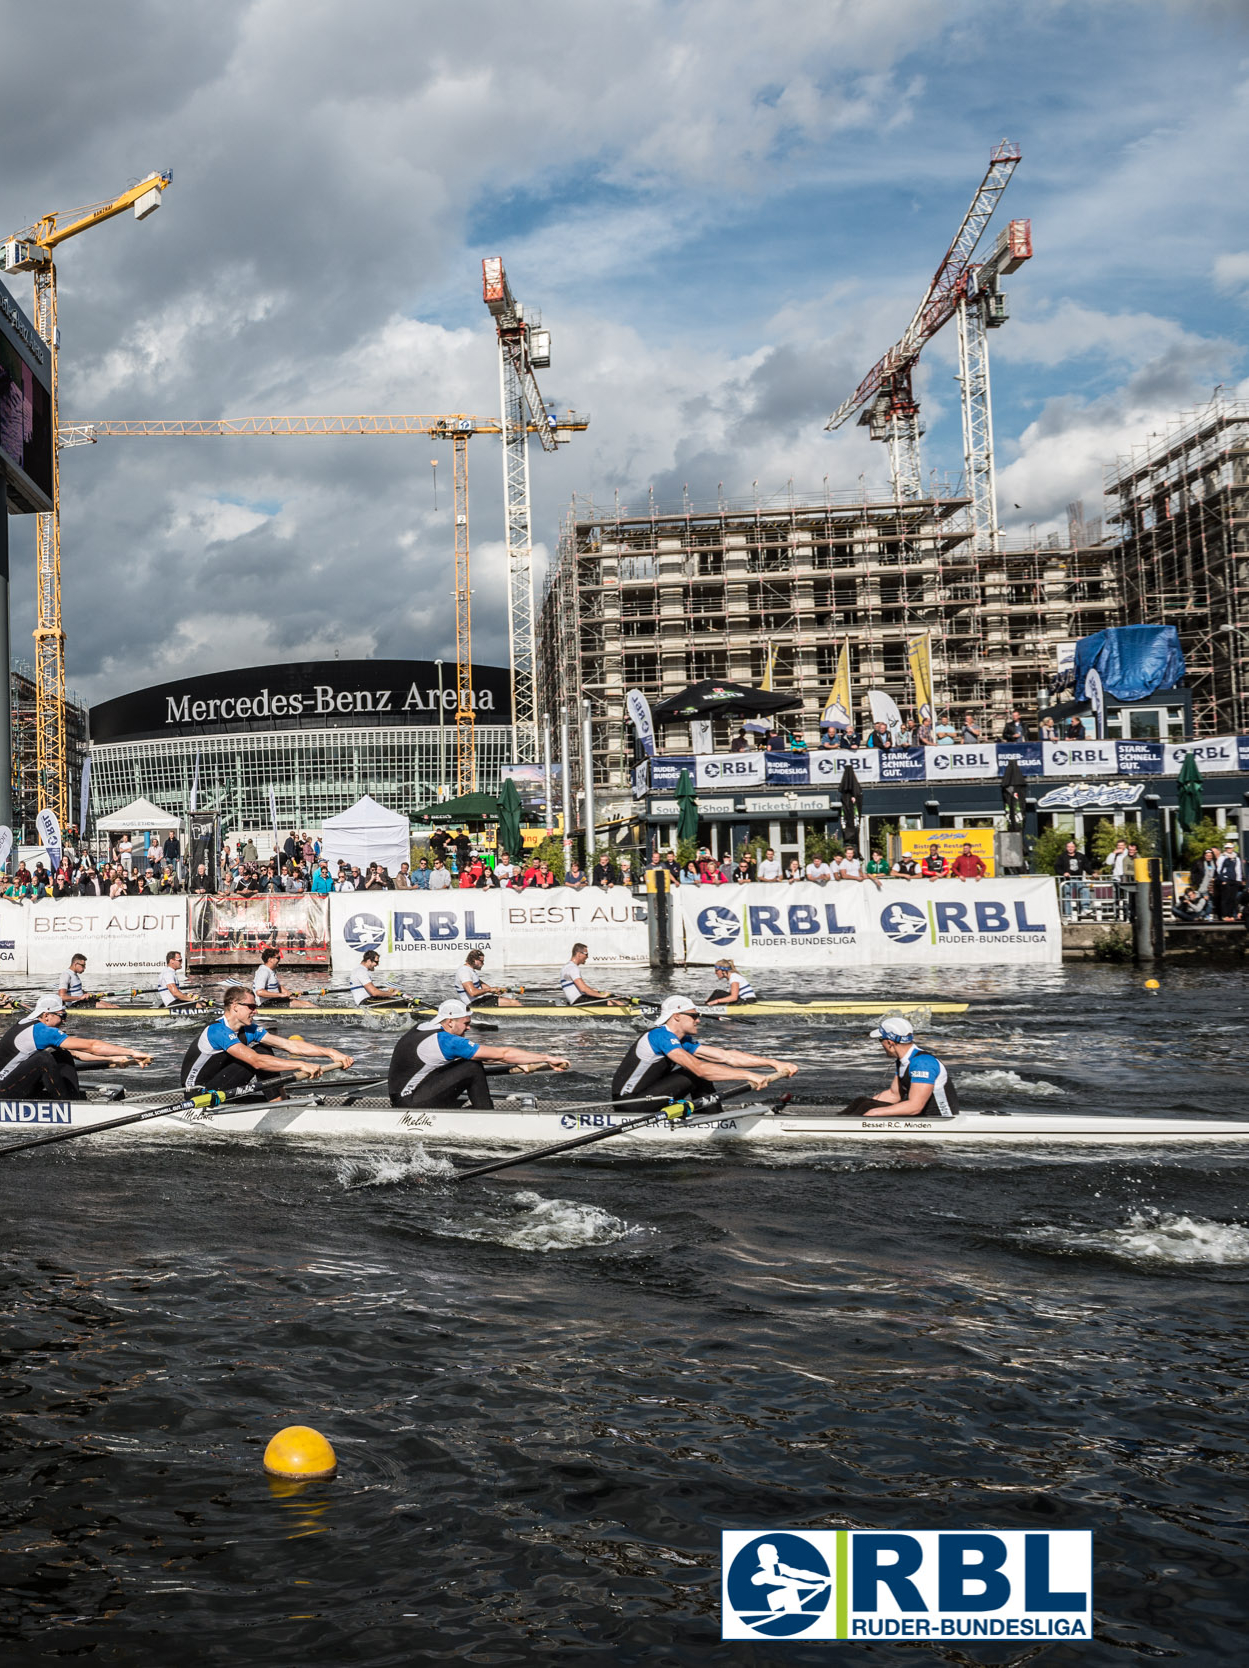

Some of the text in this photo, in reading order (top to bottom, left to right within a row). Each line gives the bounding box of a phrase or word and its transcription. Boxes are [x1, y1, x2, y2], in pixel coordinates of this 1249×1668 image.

[165, 682, 495, 726] Mercedes-Benz Arena
[1118, 745, 1151, 753] STARK.
[1193, 747, 1230, 759] RBL
[881, 752, 911, 760] STARK.
[953, 753, 990, 766] RBL
[1071, 750, 1109, 762] RBL
[1118, 753, 1161, 761] SCHNELL.
[723, 761, 759, 774] RBL
[836, 757, 872, 770] RBL
[882, 760, 923, 769] SCHNELL.
[1119, 762, 1141, 770] GUT.
[882, 769, 903, 777] GUT.
[752, 802, 791, 811] Tickets
[800, 801, 824, 810] Info
[508, 906, 648, 924] BEST AUD
[748, 903, 857, 936] RBL
[935, 900, 1047, 933] RBL
[34, 914, 181, 933] BEST AUDIT
[394, 910, 492, 942] RBL
[751, 936, 857, 946] RUDER-BUNDESLIGA
[938, 934, 1047, 944] RUDER-BUNDESLIGA
[395, 942, 492, 952] RUDER-BUNDESLIGA
[397, 1110, 434, 1127] Melitta
[580, 1114, 617, 1127] RBL
[861, 1121, 932, 1129] Bessel-R.C. Minden
